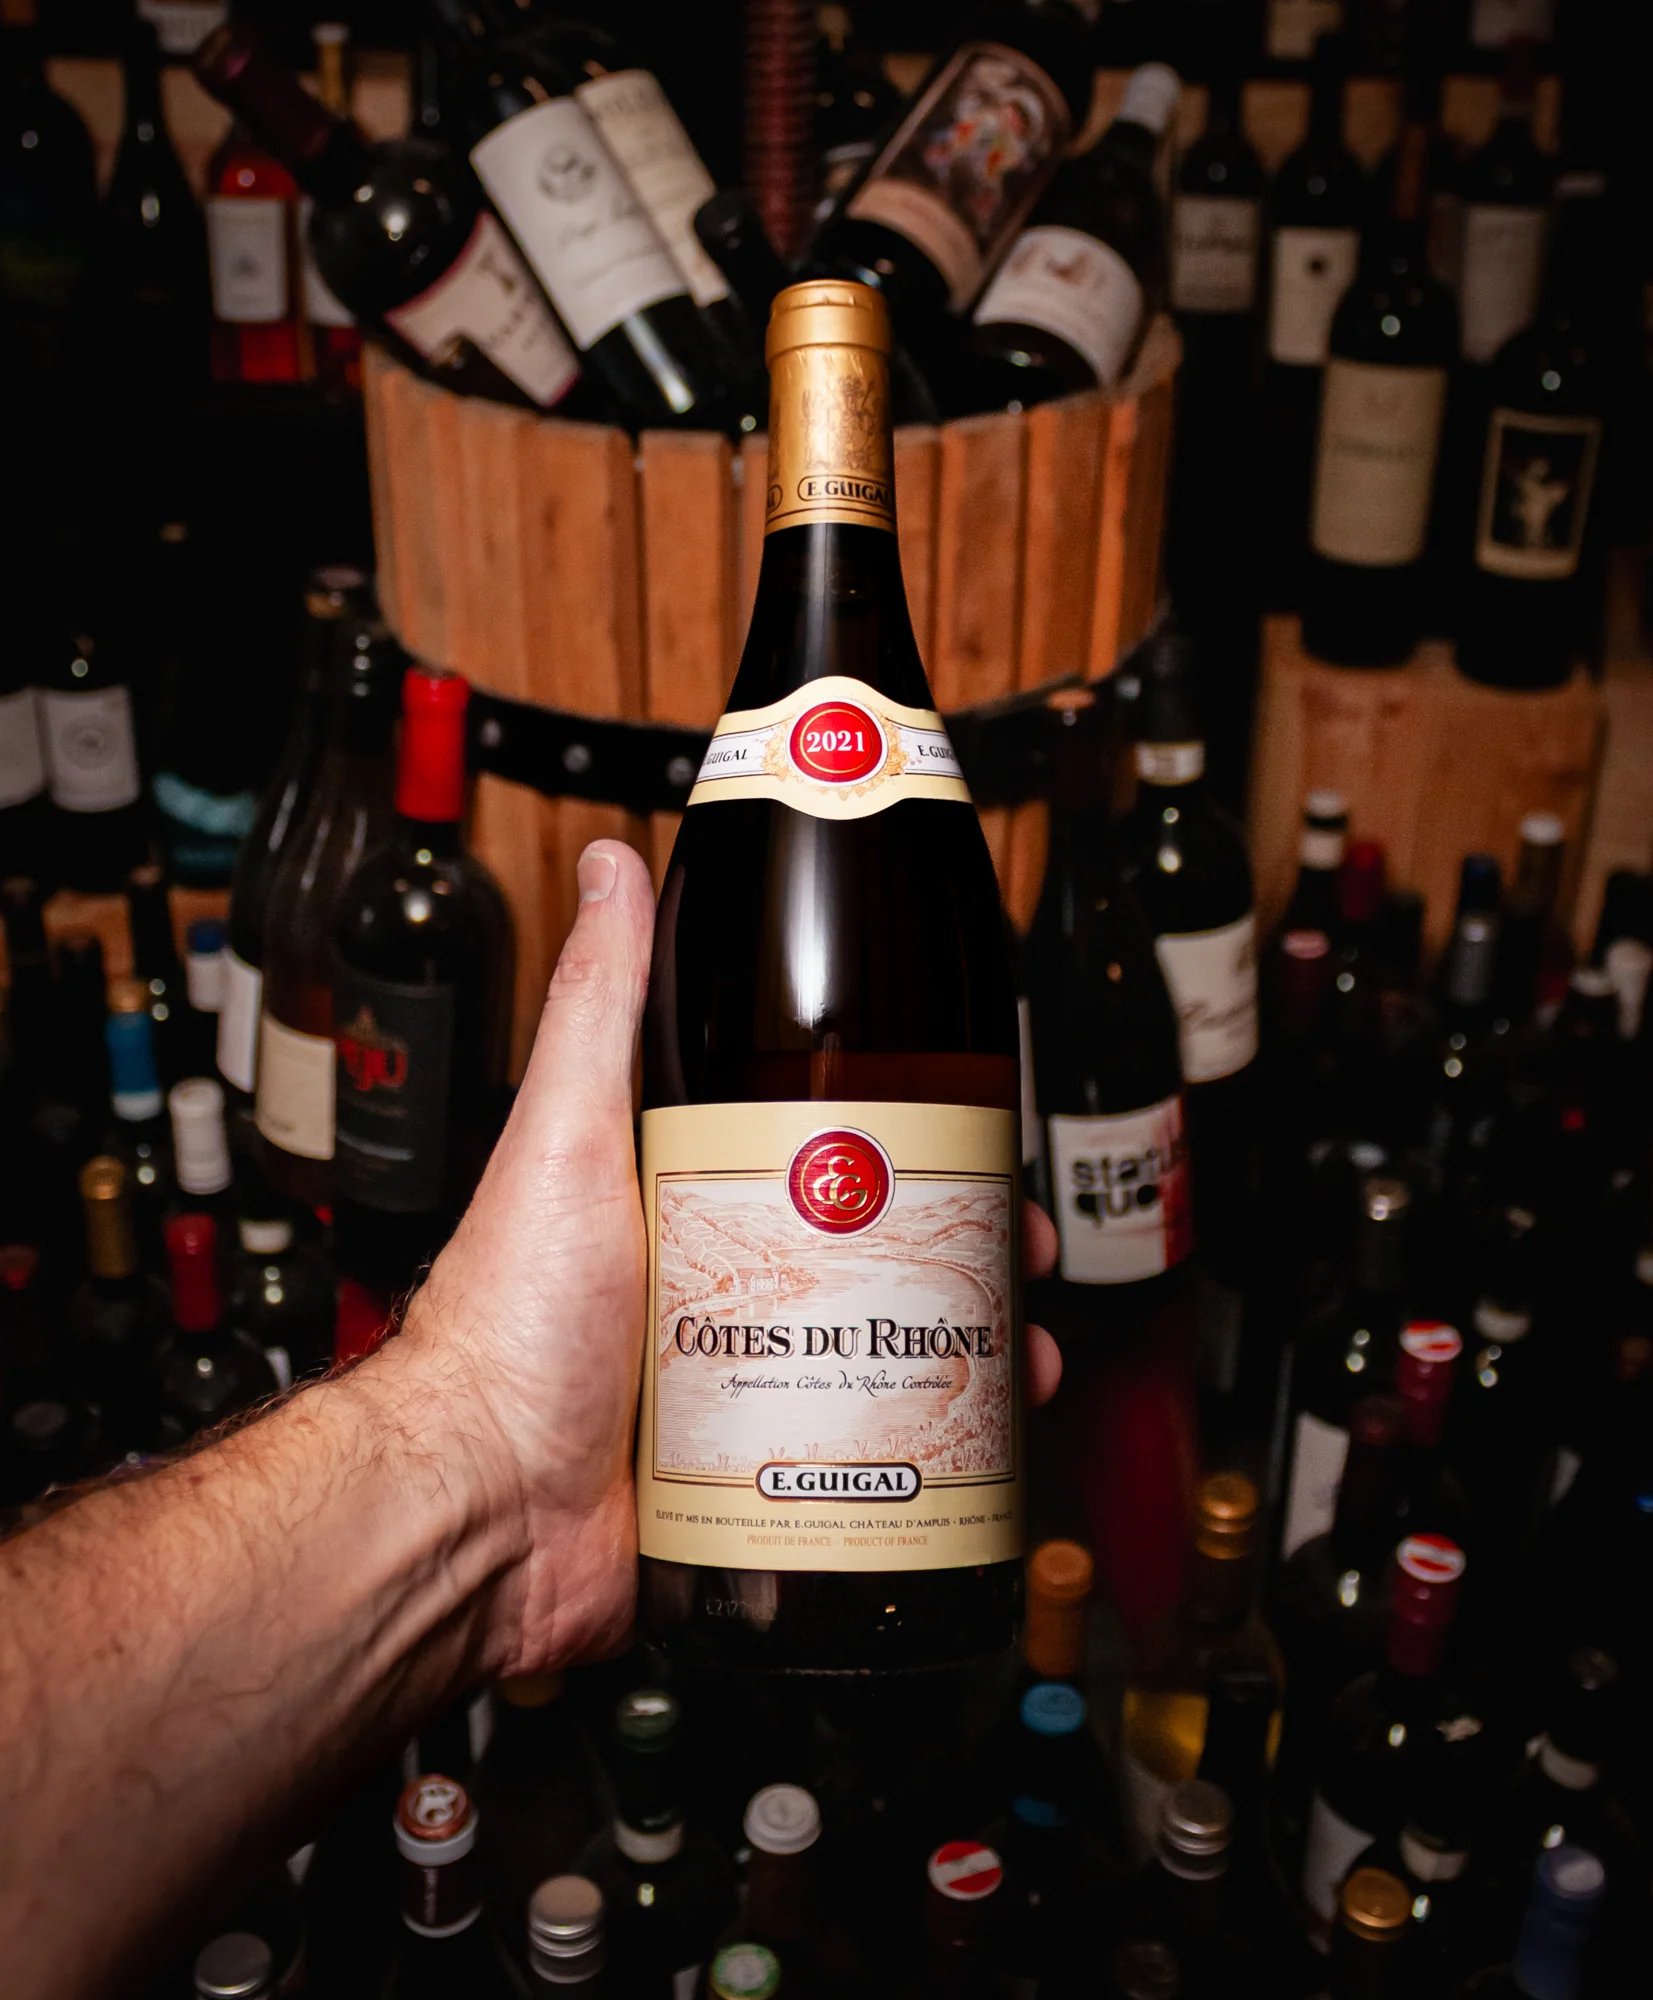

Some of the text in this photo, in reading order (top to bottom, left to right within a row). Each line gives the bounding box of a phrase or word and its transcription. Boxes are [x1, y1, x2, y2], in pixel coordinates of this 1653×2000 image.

[806, 730, 865, 753] 2021
[1074, 1182, 1160, 1230] quo
[675, 1314, 995, 1360] CÔTES DU RHÔNE
[720, 1373, 790, 1399] Appellation
[796, 1375, 832, 1390] Côtes
[856, 1369, 897, 1398] Rhône
[901, 1374, 953, 1390] Contrôlée
[675, 1513, 684, 1523] ET
[686, 1514, 700, 1524] MIS
[701, 1515, 713, 1525] EN
[715, 1516, 767, 1528] BOUTEILLE
[770, 1519, 791, 1529] PAR
[849, 1516, 902, 1530] CHÂTEAU
[906, 1517, 951, 1529] D'AMPUIS
[959, 1513, 986, 1526] RHÔNE
[746, 1534, 929, 1547] PRODUIT DE FRANCE PRODUCT OF FRANCE
